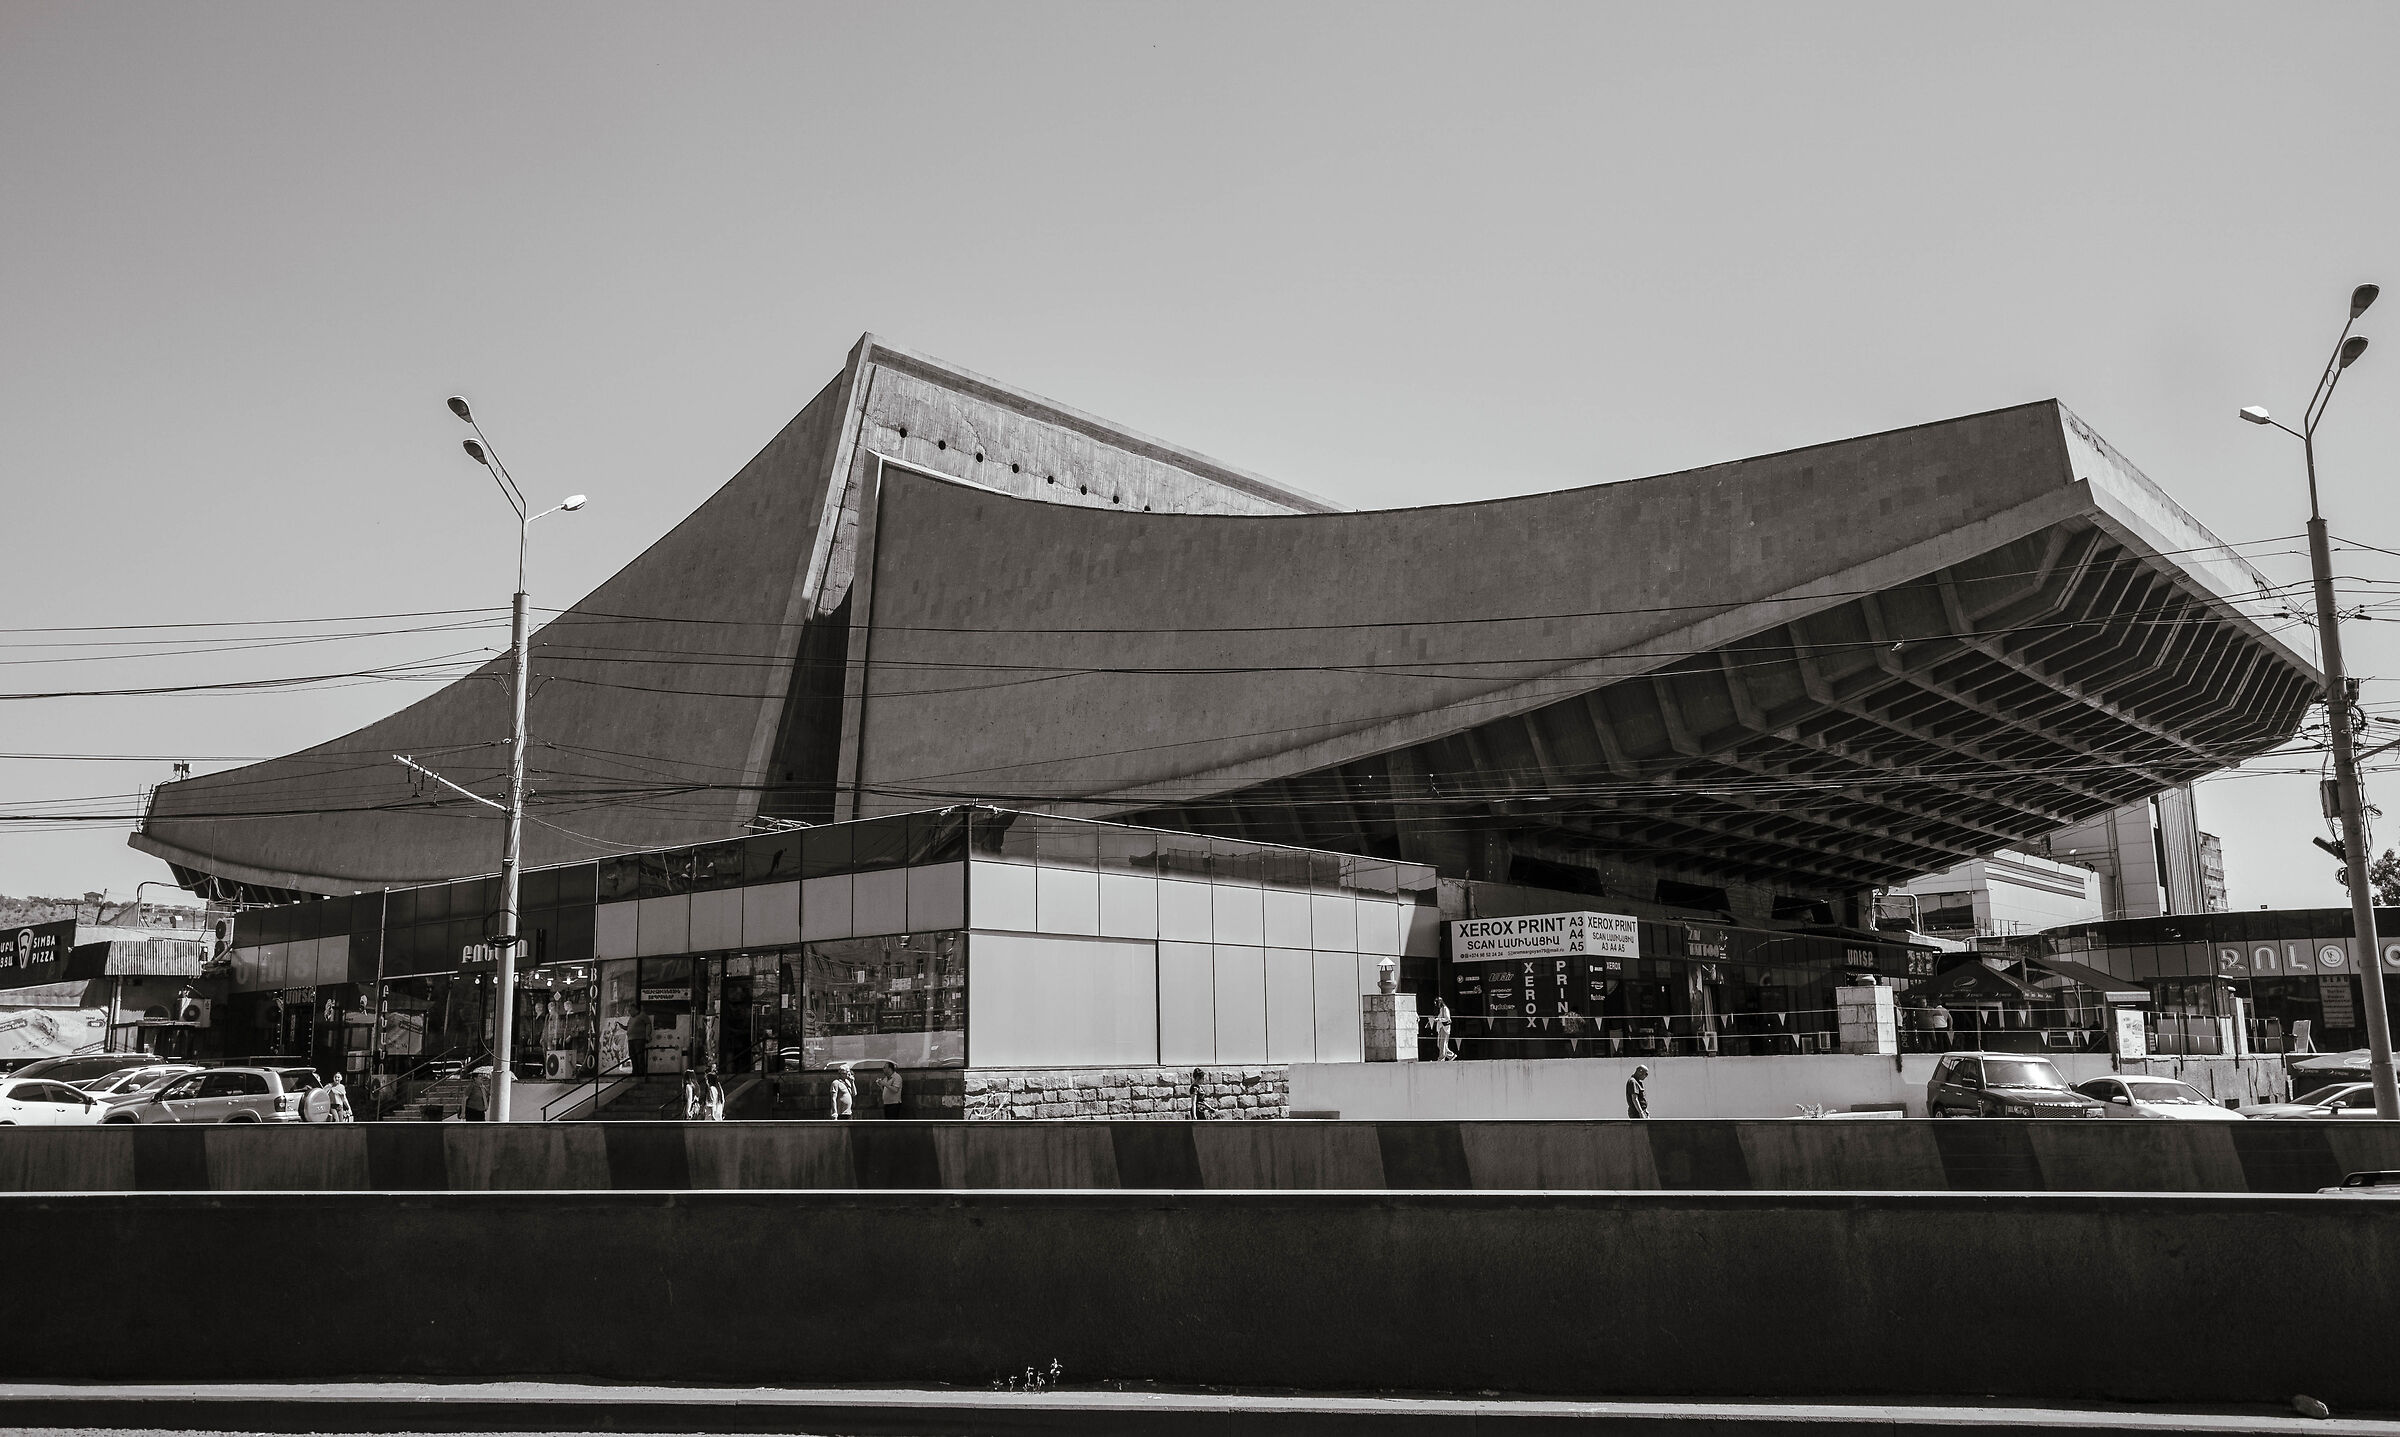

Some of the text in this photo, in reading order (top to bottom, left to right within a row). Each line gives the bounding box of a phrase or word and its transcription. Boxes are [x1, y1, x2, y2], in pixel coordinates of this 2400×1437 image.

[1459, 917, 1566, 938] XEROX PRINT
[1569, 916, 1584, 927] A3
[1587, 916, 1636, 932] XEROX PRINT
[1569, 928, 1584, 940] A4
[1592, 932, 1607, 940] SCAN
[33, 935, 56, 949] SIMBA
[1467, 940, 1495, 951] SCAN
[1569, 941, 1584, 952] A5
[1601, 942, 1626, 953] A3 A4 A5
[32, 950, 54, 964] PIZZA
[1524, 962, 1537, 1028] XEROX
[1556, 960, 1569, 1027] PRINT
